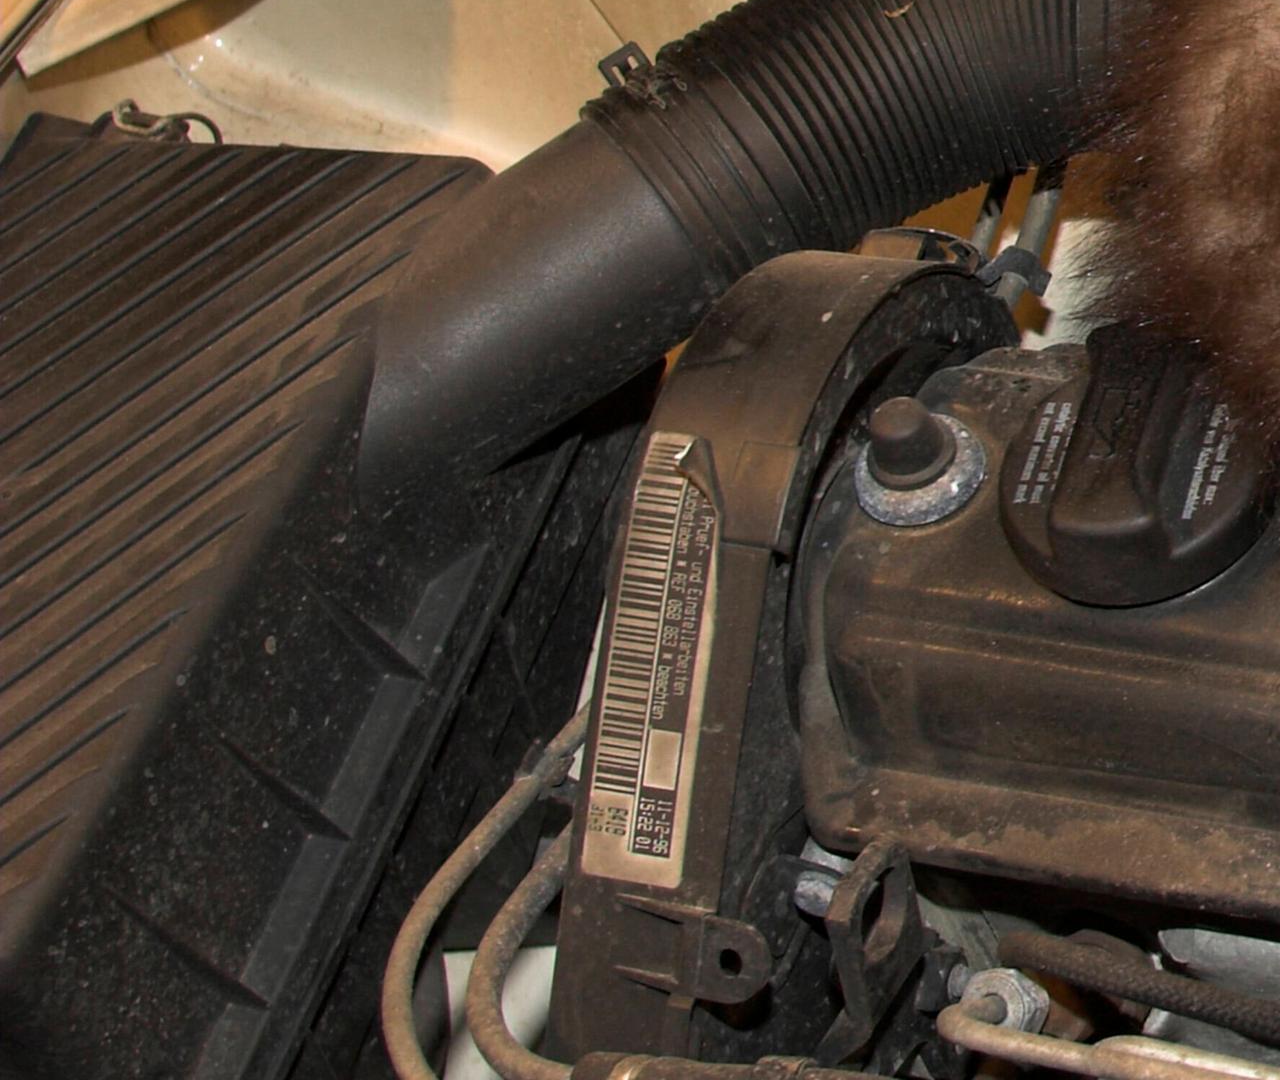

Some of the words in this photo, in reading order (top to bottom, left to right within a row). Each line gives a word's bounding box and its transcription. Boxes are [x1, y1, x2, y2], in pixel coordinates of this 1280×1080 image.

[671, 571, 687, 594] REF
[688, 562, 704, 584] und
[665, 599, 682, 621] 068
[661, 625, 679, 648] 863
[673, 587, 703, 696] Einstellarbeiten
[651, 665, 672, 720] beachten
[637, 797, 656, 832] 15:22
[652, 800, 673, 855] 11-12-96
[635, 836, 651, 850] 01
